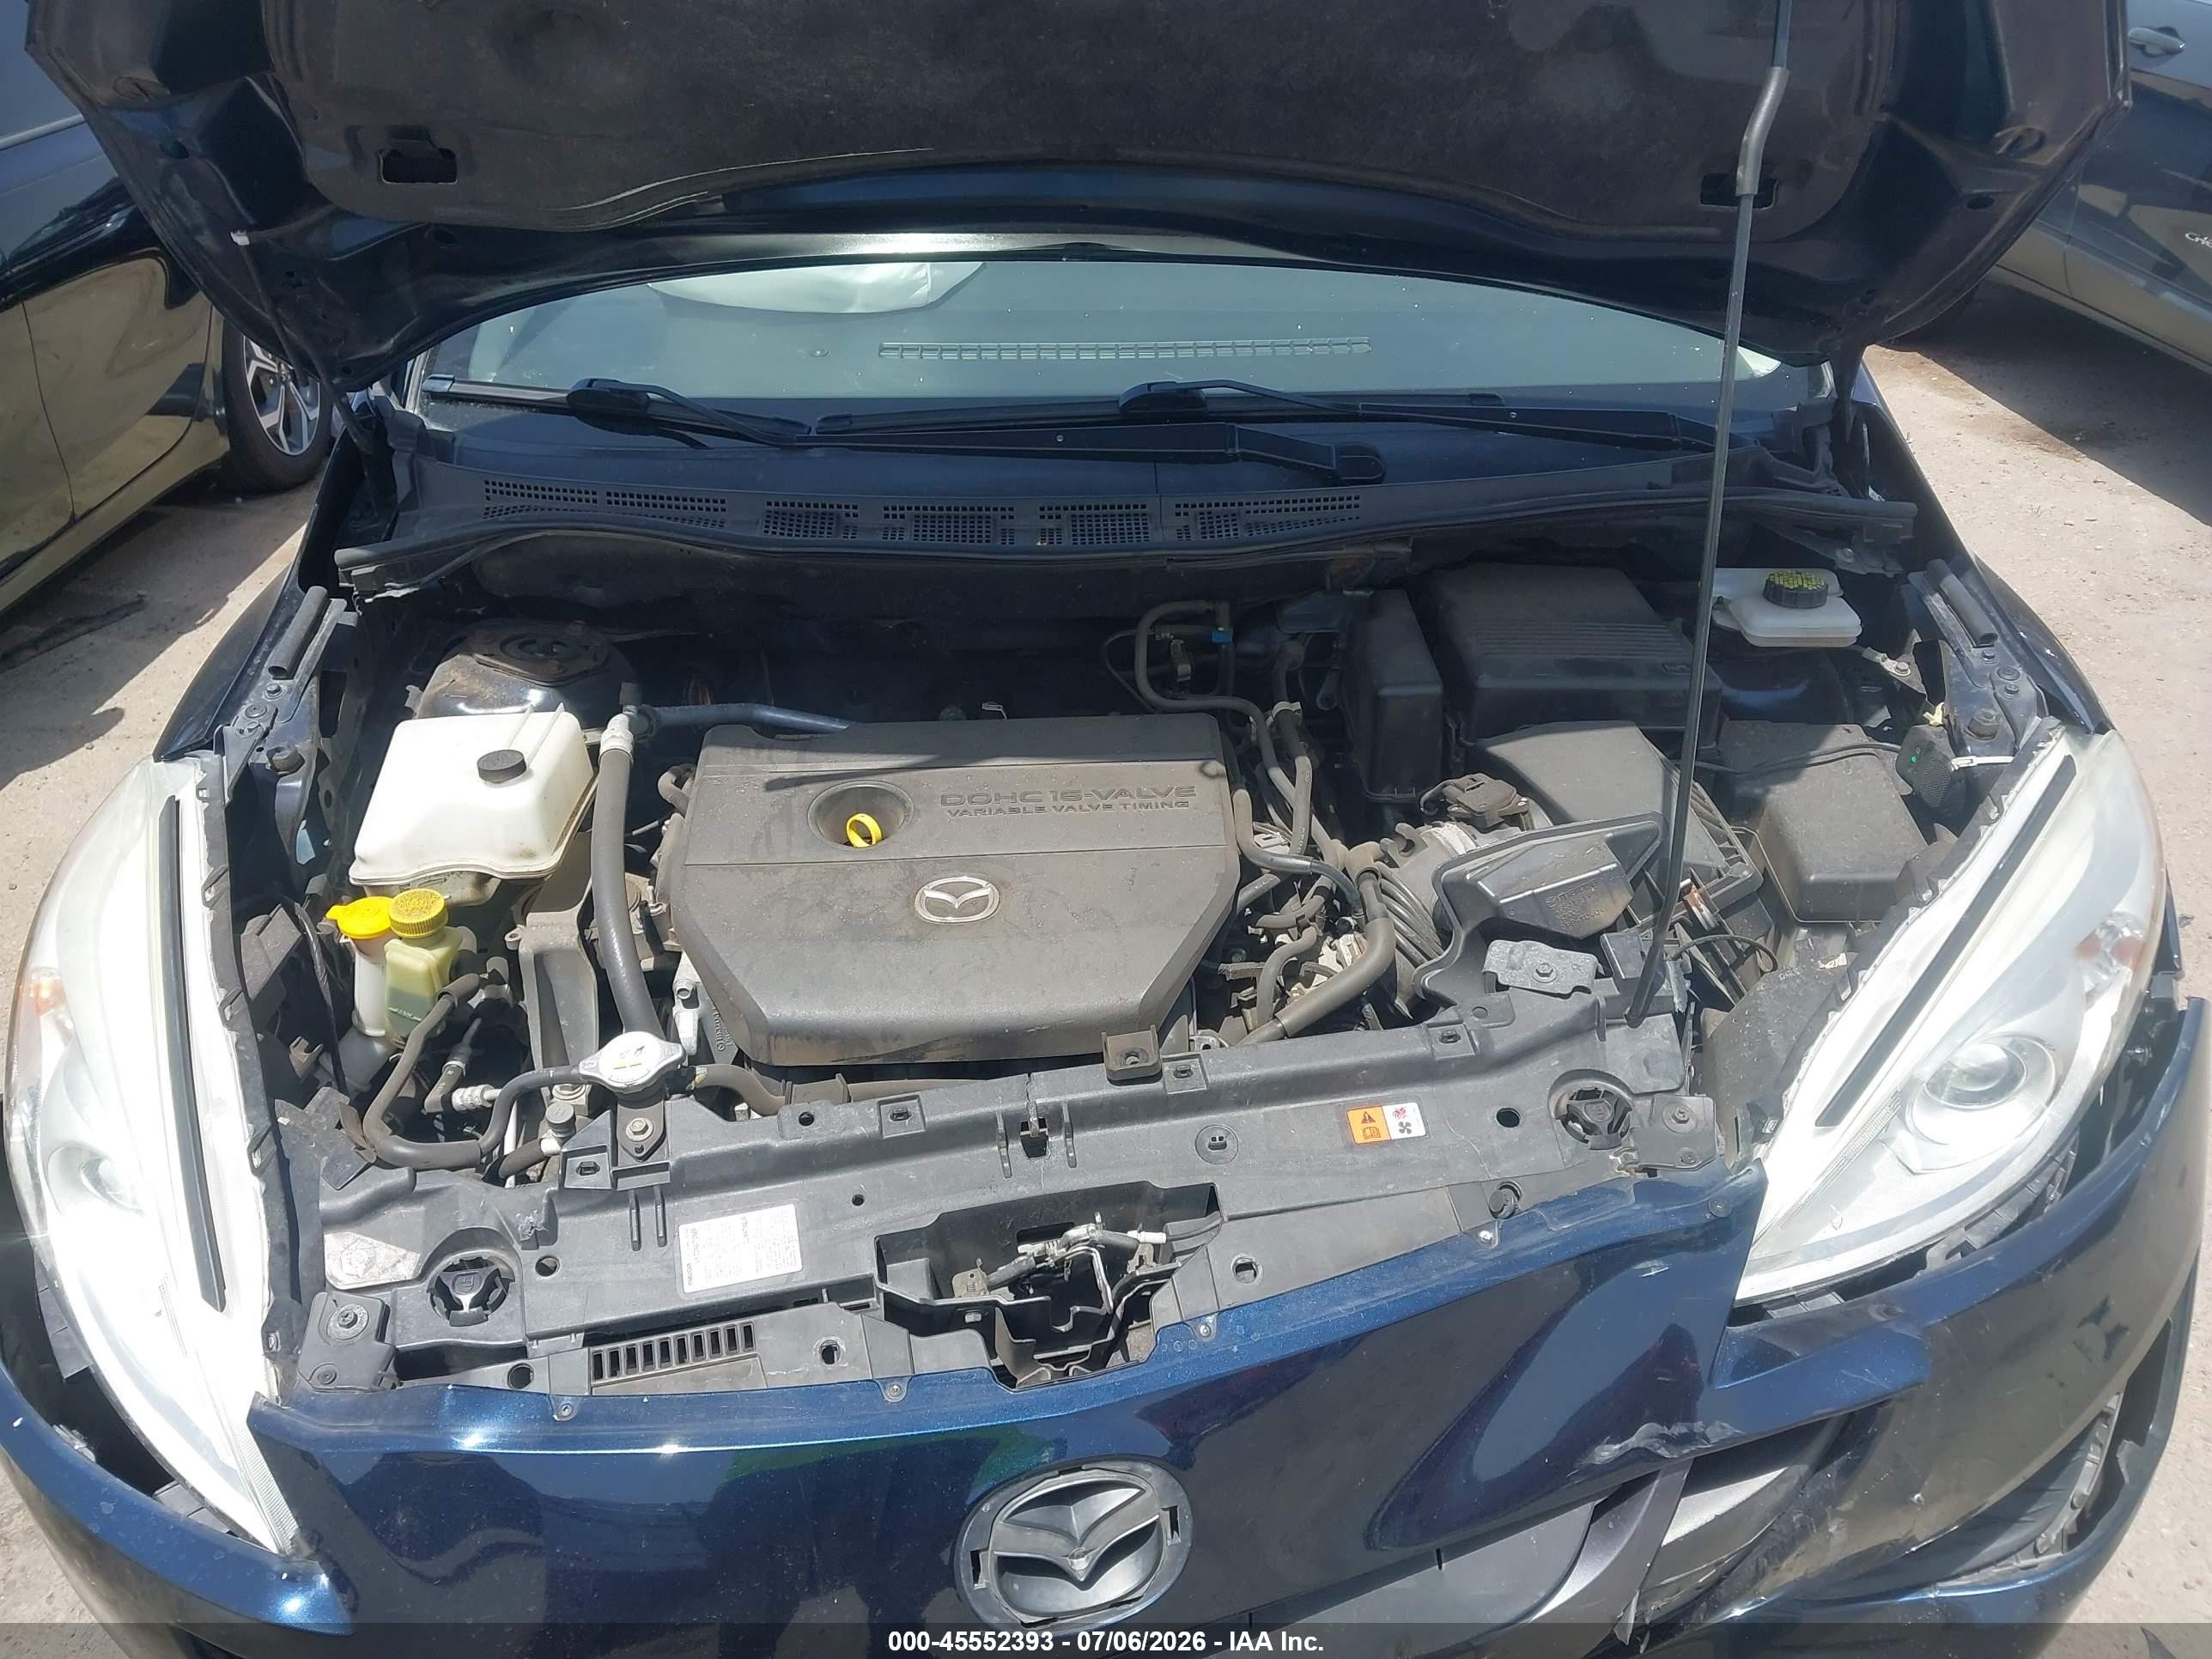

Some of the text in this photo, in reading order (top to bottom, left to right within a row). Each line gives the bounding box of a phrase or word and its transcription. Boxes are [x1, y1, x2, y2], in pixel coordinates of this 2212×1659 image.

[941, 785, 1197, 807] DOHC 16-VALVE
[947, 799, 1190, 818] VARIABLE VALVE TIMING
